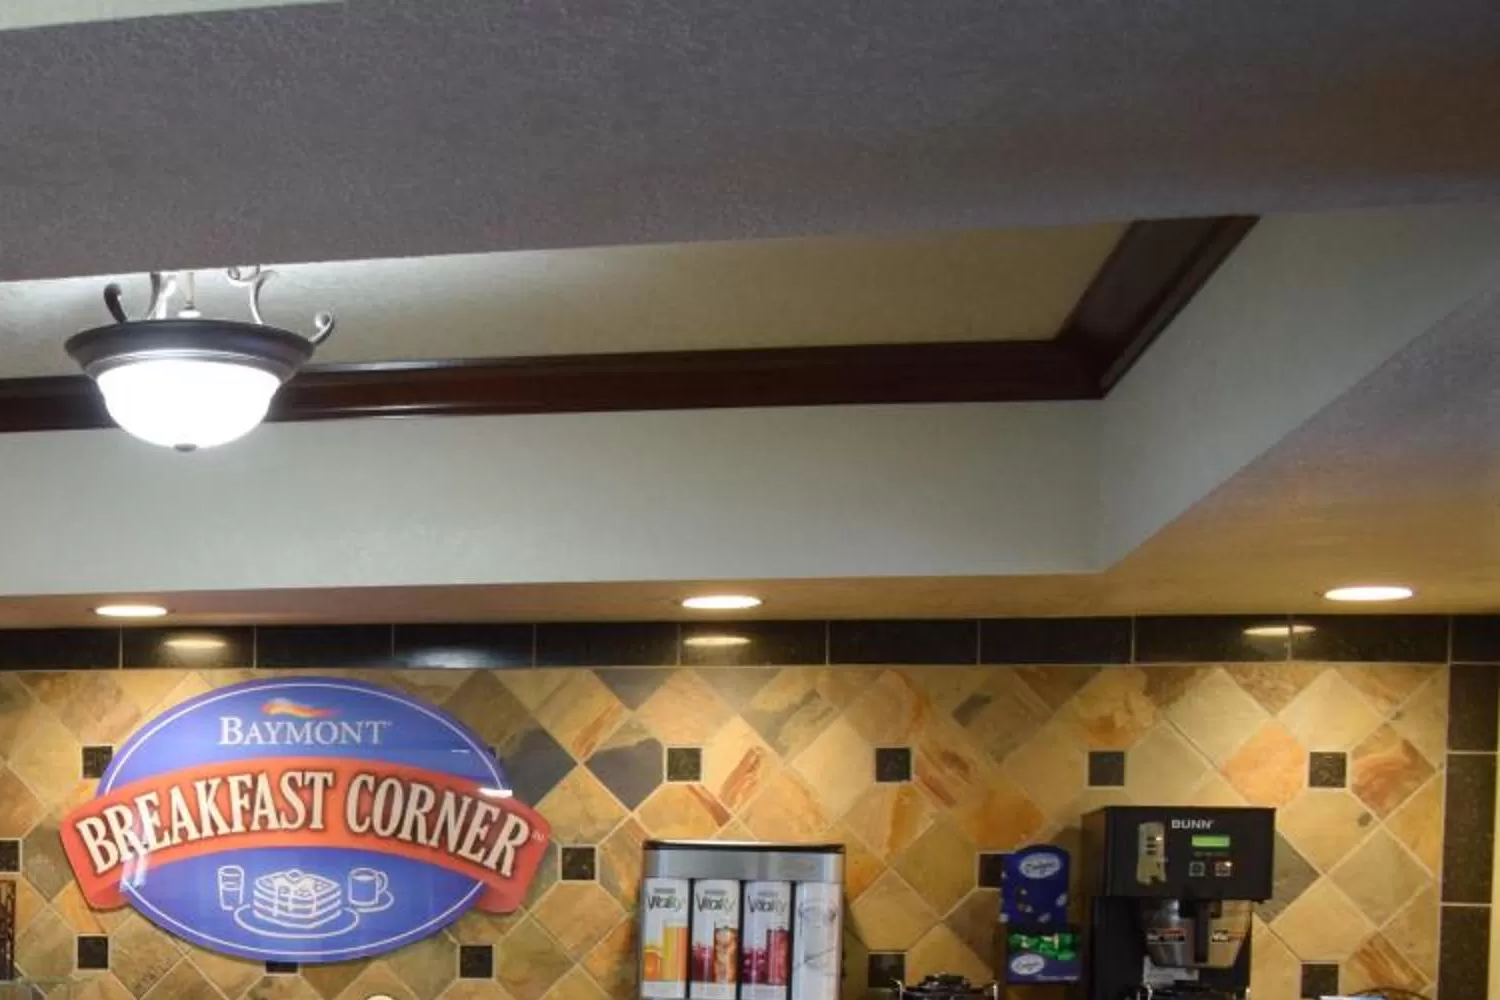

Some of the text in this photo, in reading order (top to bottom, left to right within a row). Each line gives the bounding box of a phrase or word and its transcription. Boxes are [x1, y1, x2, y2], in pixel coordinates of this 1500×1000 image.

[219, 716, 388, 746] BAYMONT
[75, 770, 531, 878] BREAKFAST CORNER
[1171, 819, 1213, 829] BUNN
